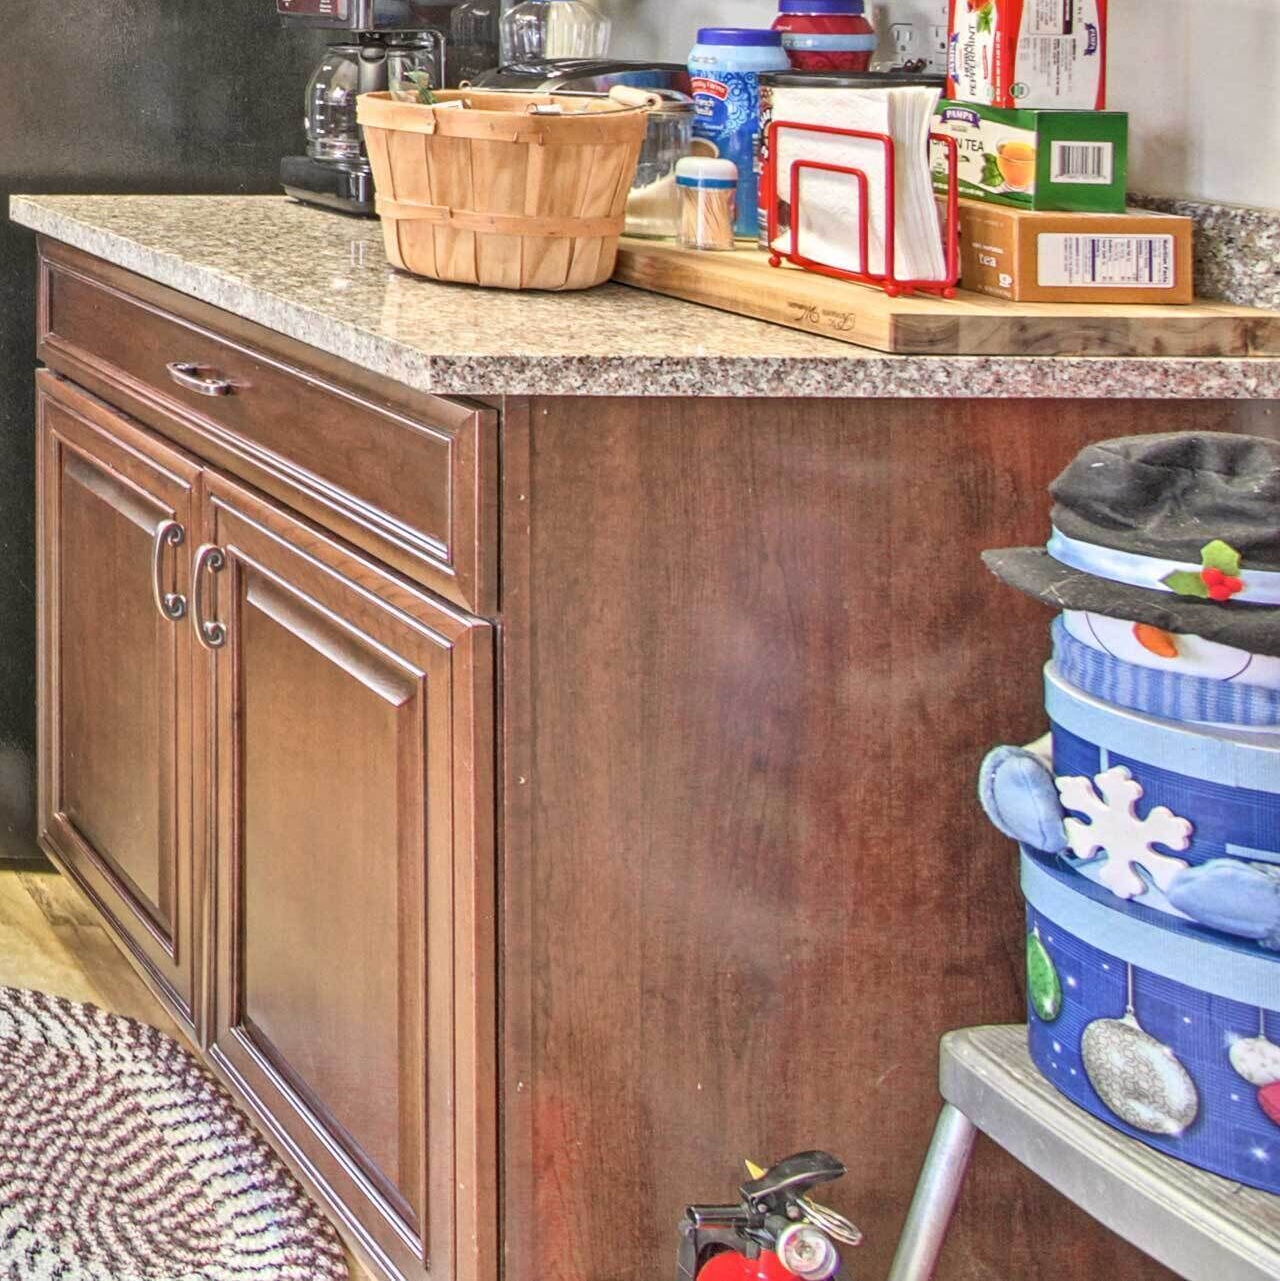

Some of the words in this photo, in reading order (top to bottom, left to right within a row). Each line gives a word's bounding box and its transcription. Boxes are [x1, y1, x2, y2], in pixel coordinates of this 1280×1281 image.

[945, 110, 973, 122] PAMPA
[965, 138, 984, 152] TEA
[979, 253, 997, 268] tea
